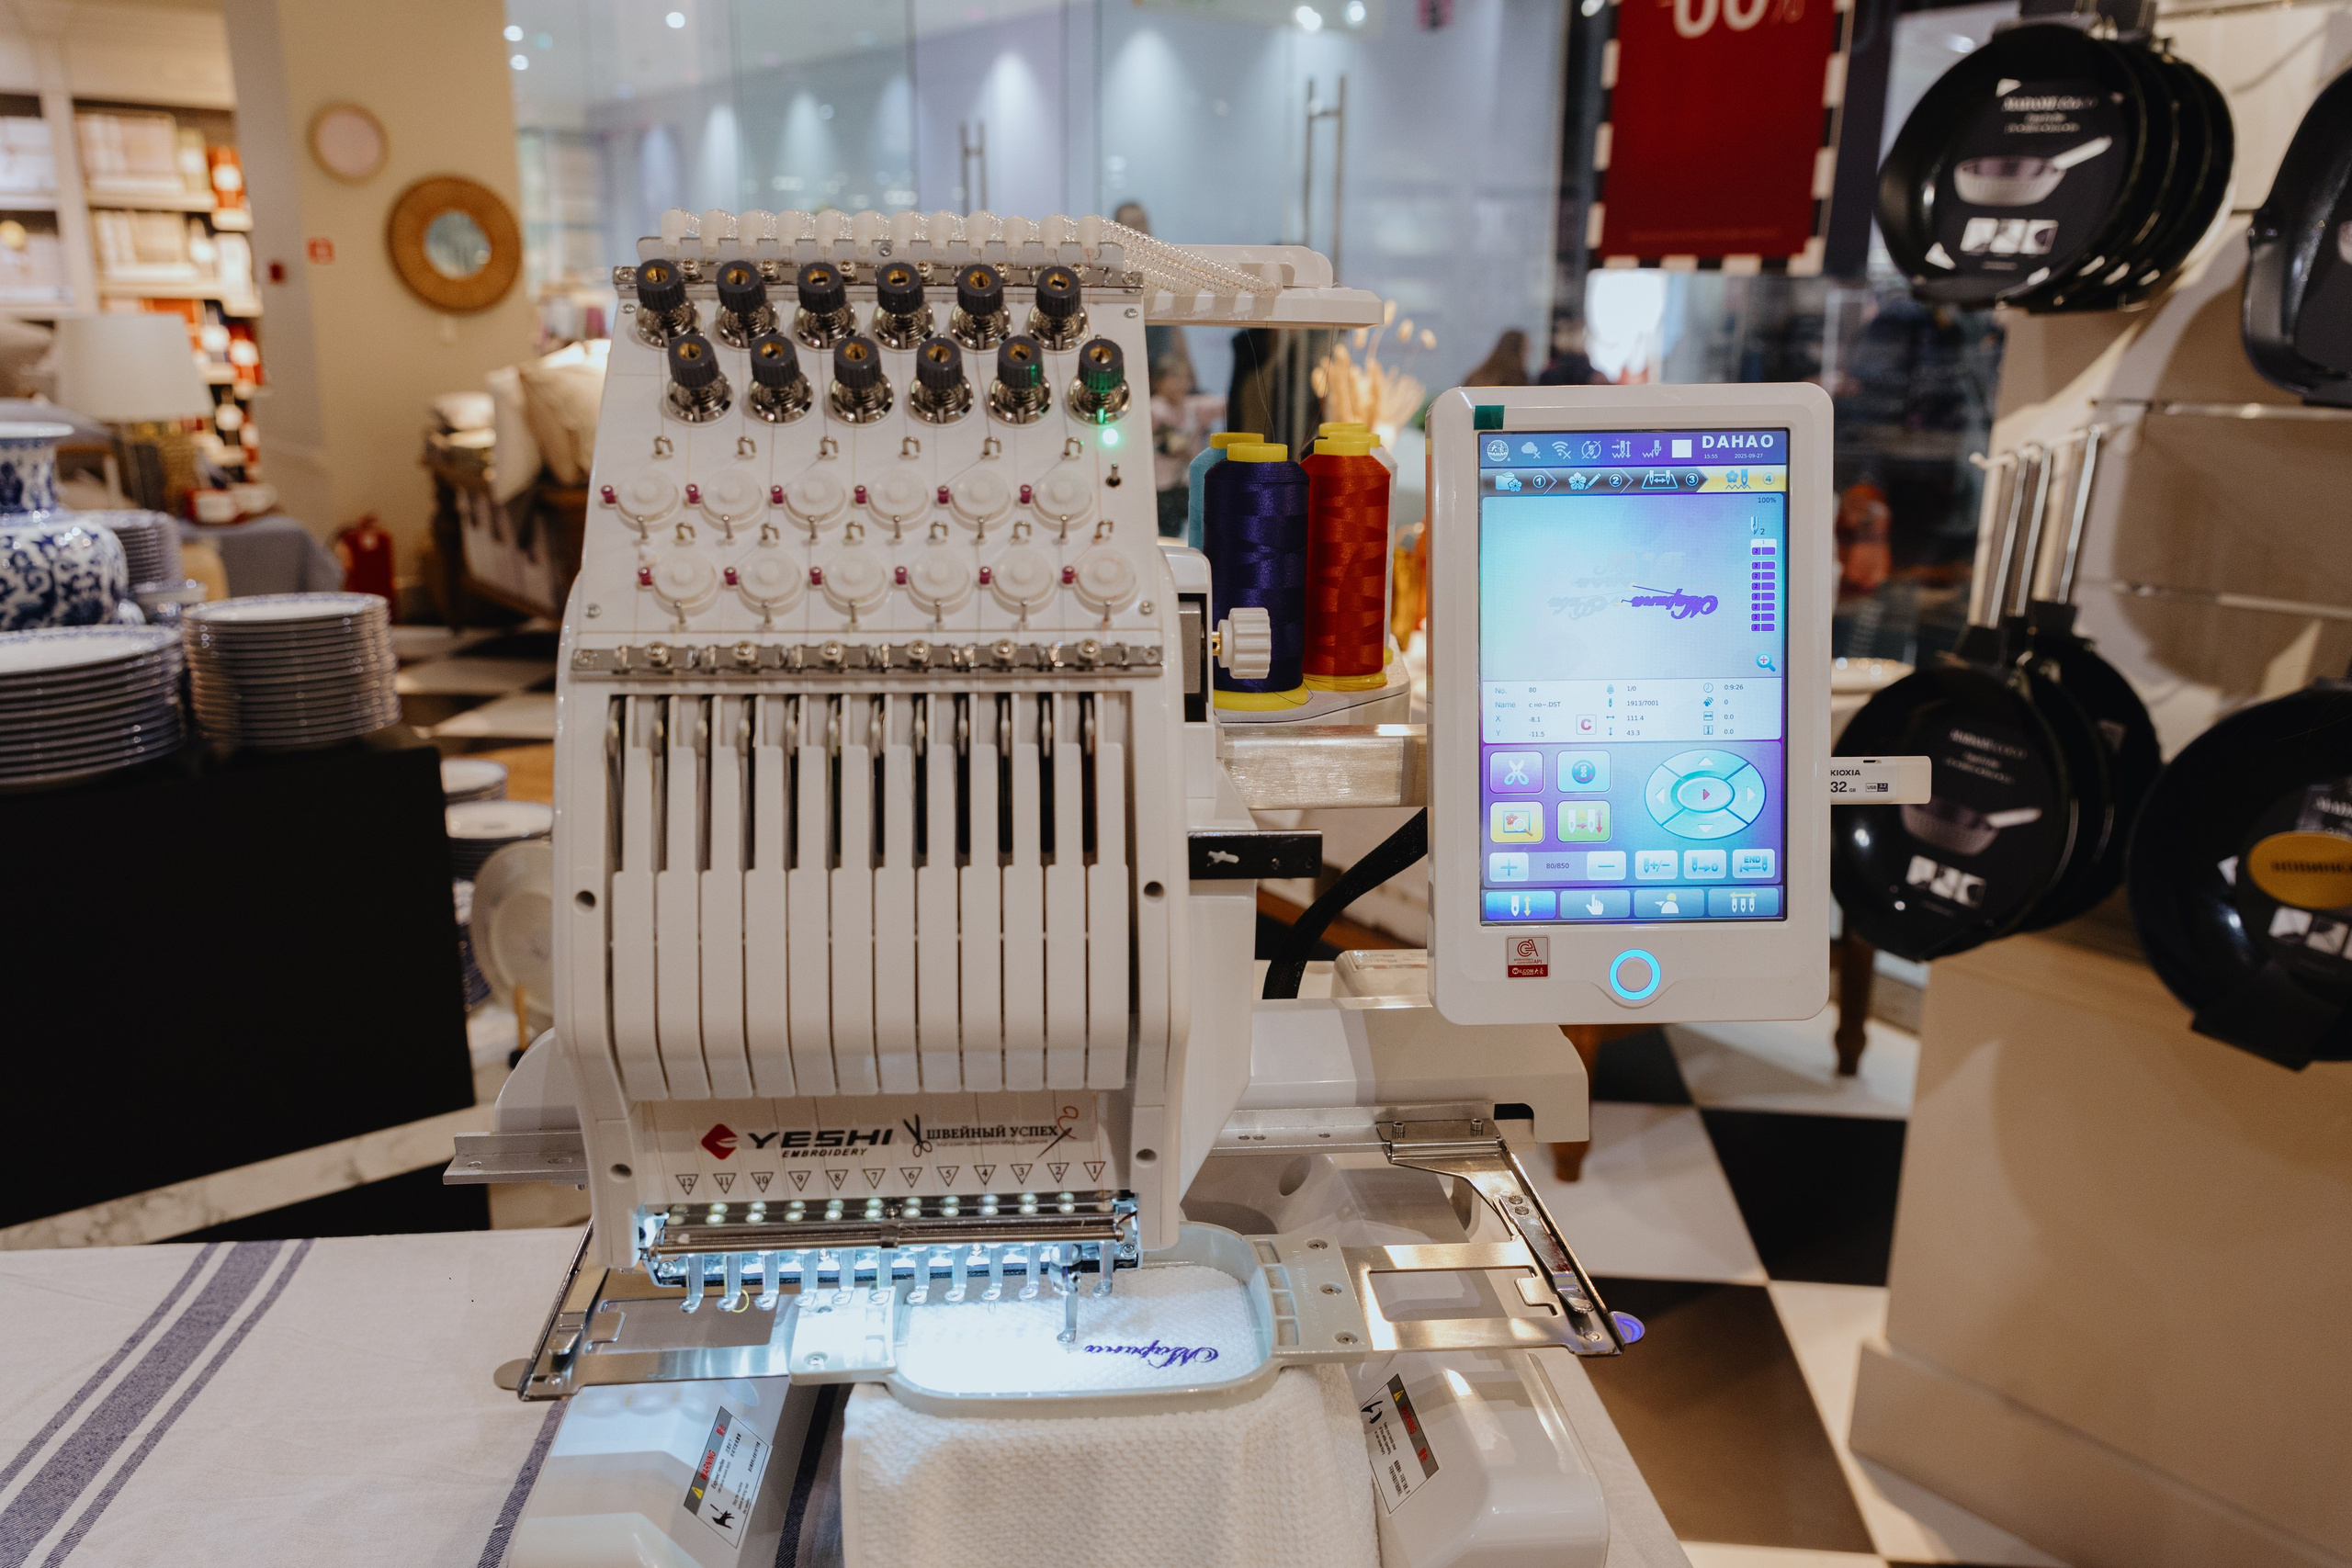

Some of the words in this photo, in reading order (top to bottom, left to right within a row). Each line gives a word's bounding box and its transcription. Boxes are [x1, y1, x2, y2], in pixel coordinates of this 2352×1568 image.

[1702, 434, 1774, 448] DAHAO
[1580, 718, 1592, 731] C
[1830, 782, 1848, 793] 32
[747, 1129, 894, 1149] YESHI
[926, 1124, 1007, 1140] ШВЕЙНЫЙ
[1010, 1125, 1059, 1137] УСПЕХ
[782, 1148, 868, 1158] EMBROIDERY
[1401, 1405, 1417, 1435] WARNING
[699, 1449, 716, 1481] WARNING
